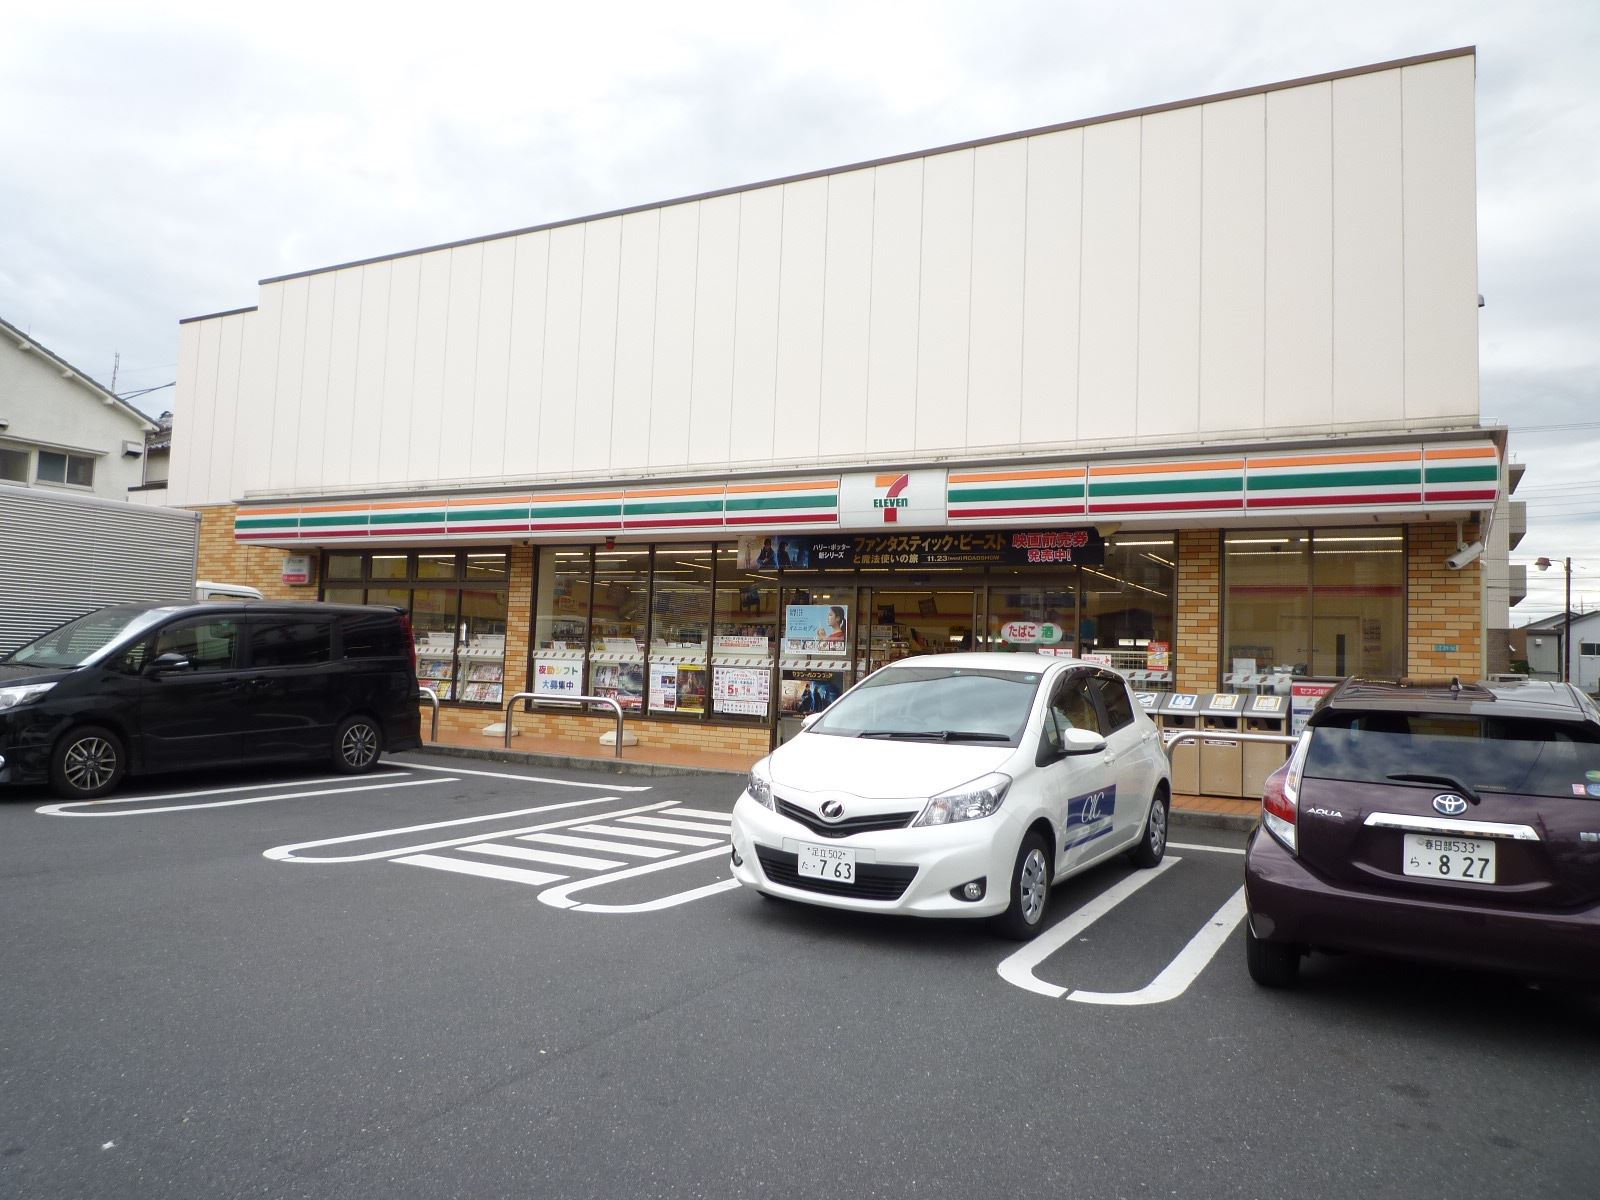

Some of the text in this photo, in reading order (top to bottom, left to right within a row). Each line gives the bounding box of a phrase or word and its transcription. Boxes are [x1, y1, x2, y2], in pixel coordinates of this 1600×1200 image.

[1012, 531, 1088, 548] 映画前売券
[818, 551, 844, 559] 新シリーズ
[853, 554, 919, 564] と魔法使いの旅
[1008, 625, 1054, 638] たばこ 酒
[538, 665, 578, 676] 夜勤シフト
[542, 680, 574, 690] 大募集中
[1306, 807, 1343, 818] AQUA
